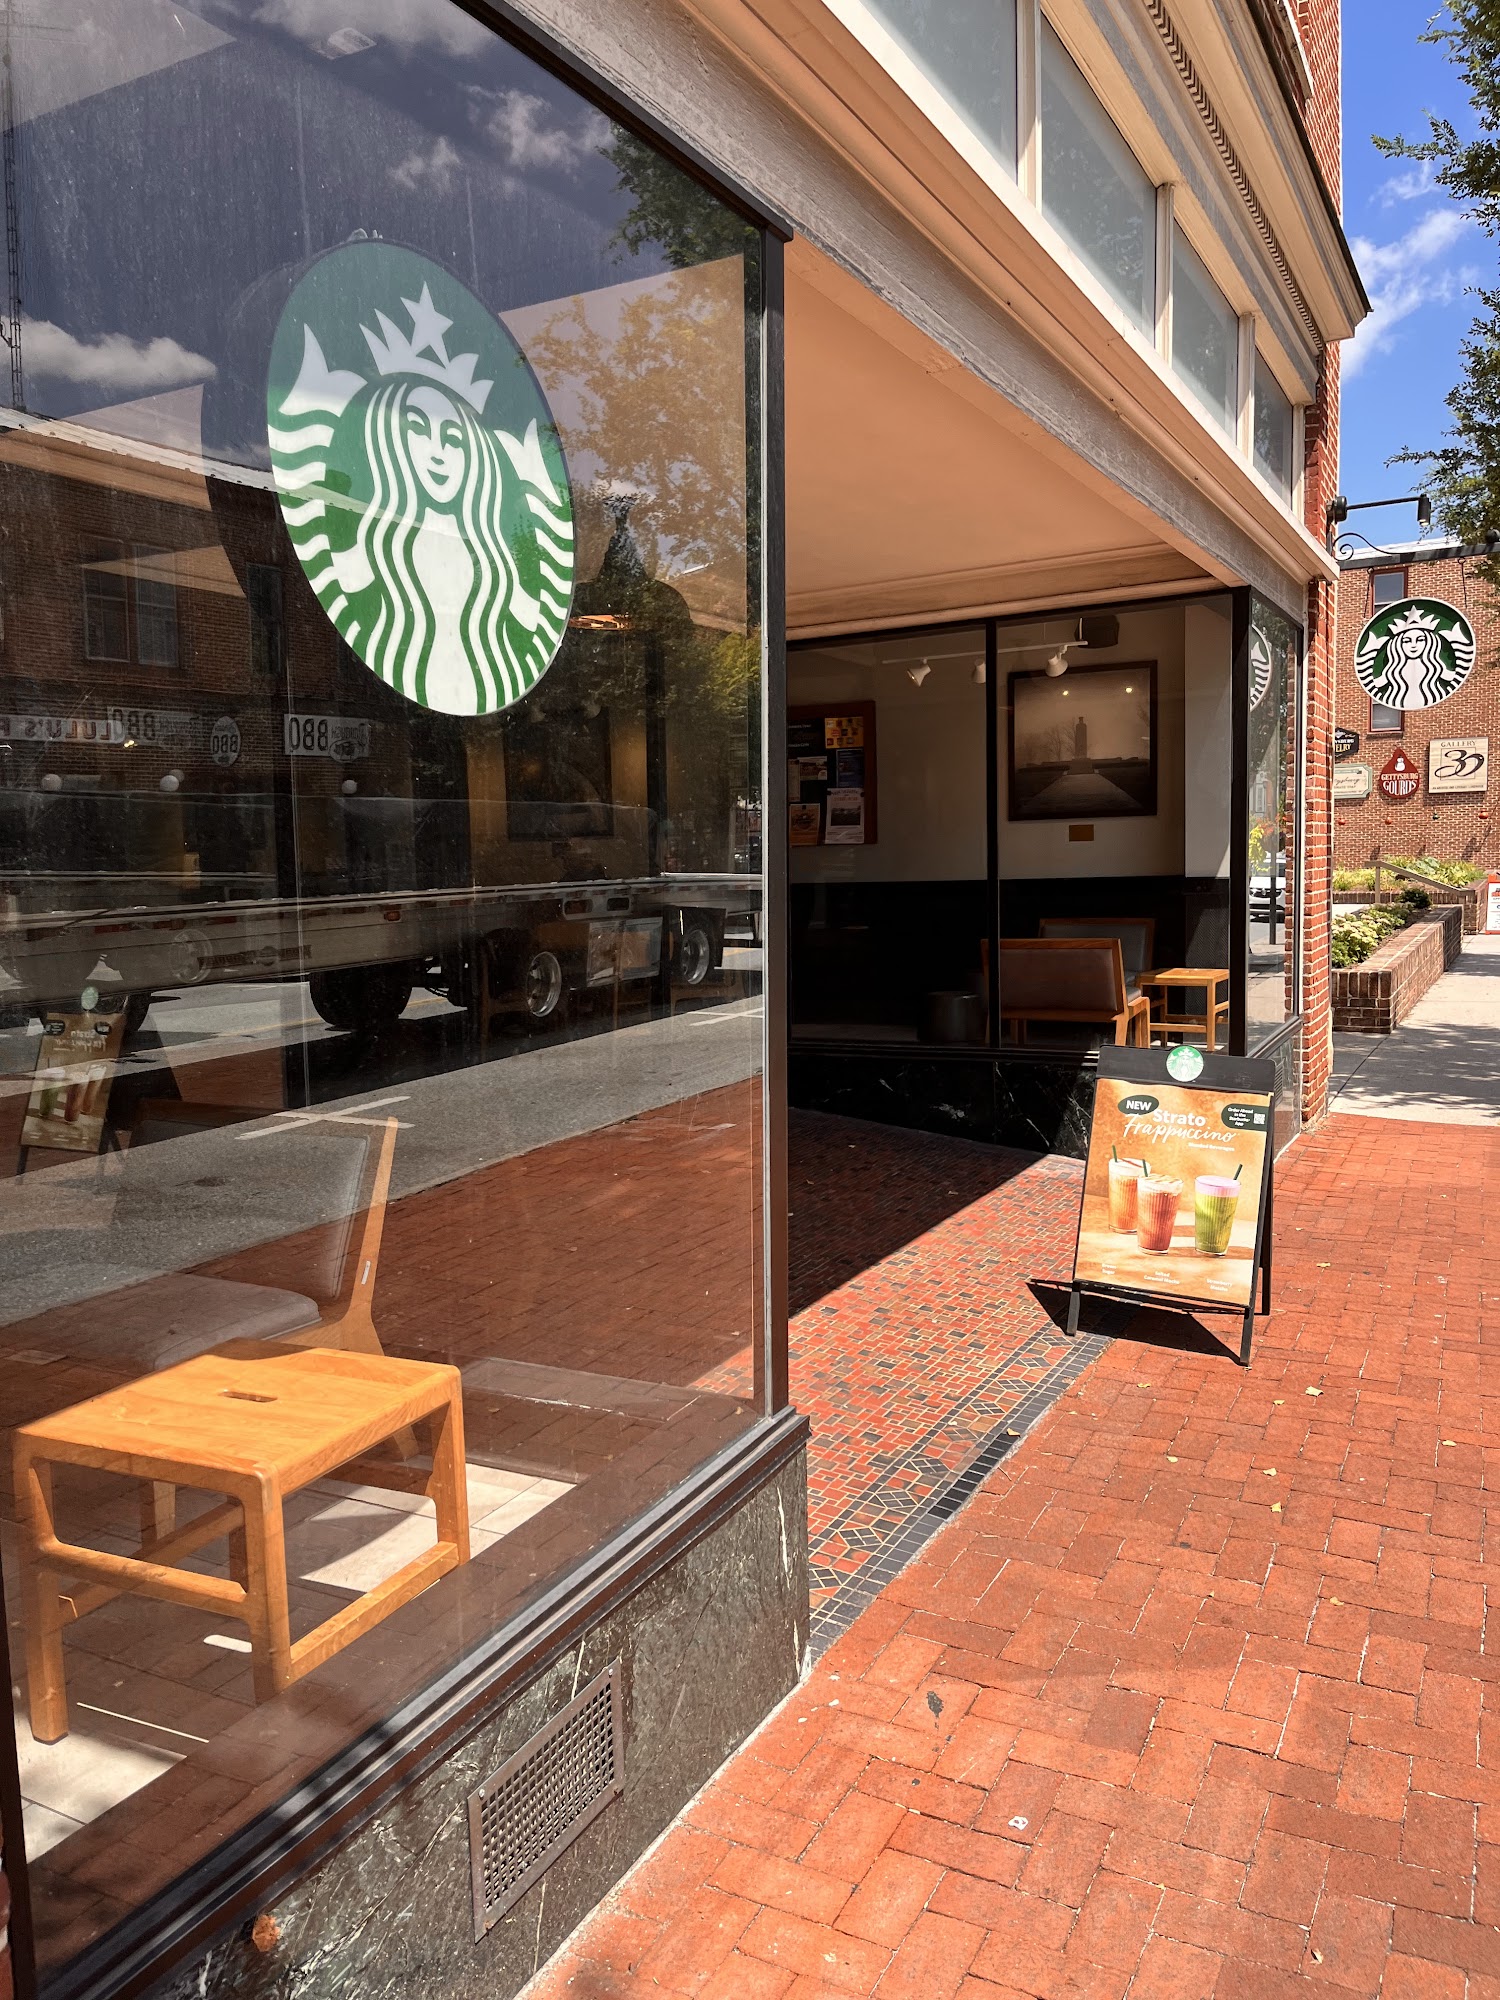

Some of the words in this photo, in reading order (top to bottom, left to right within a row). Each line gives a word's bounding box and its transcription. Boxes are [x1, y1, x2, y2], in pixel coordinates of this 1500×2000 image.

[1440, 740, 1477, 748] GALLERY
[1434, 749, 1485, 779] 30
[1381, 773, 1418, 781] GETTYSBURG
[1382, 779, 1417, 796] GOURDS
[1125, 1099, 1153, 1111] NEW
[1152, 1109, 1206, 1126] Strato
[1123, 1113, 1236, 1143] Frappuccino
